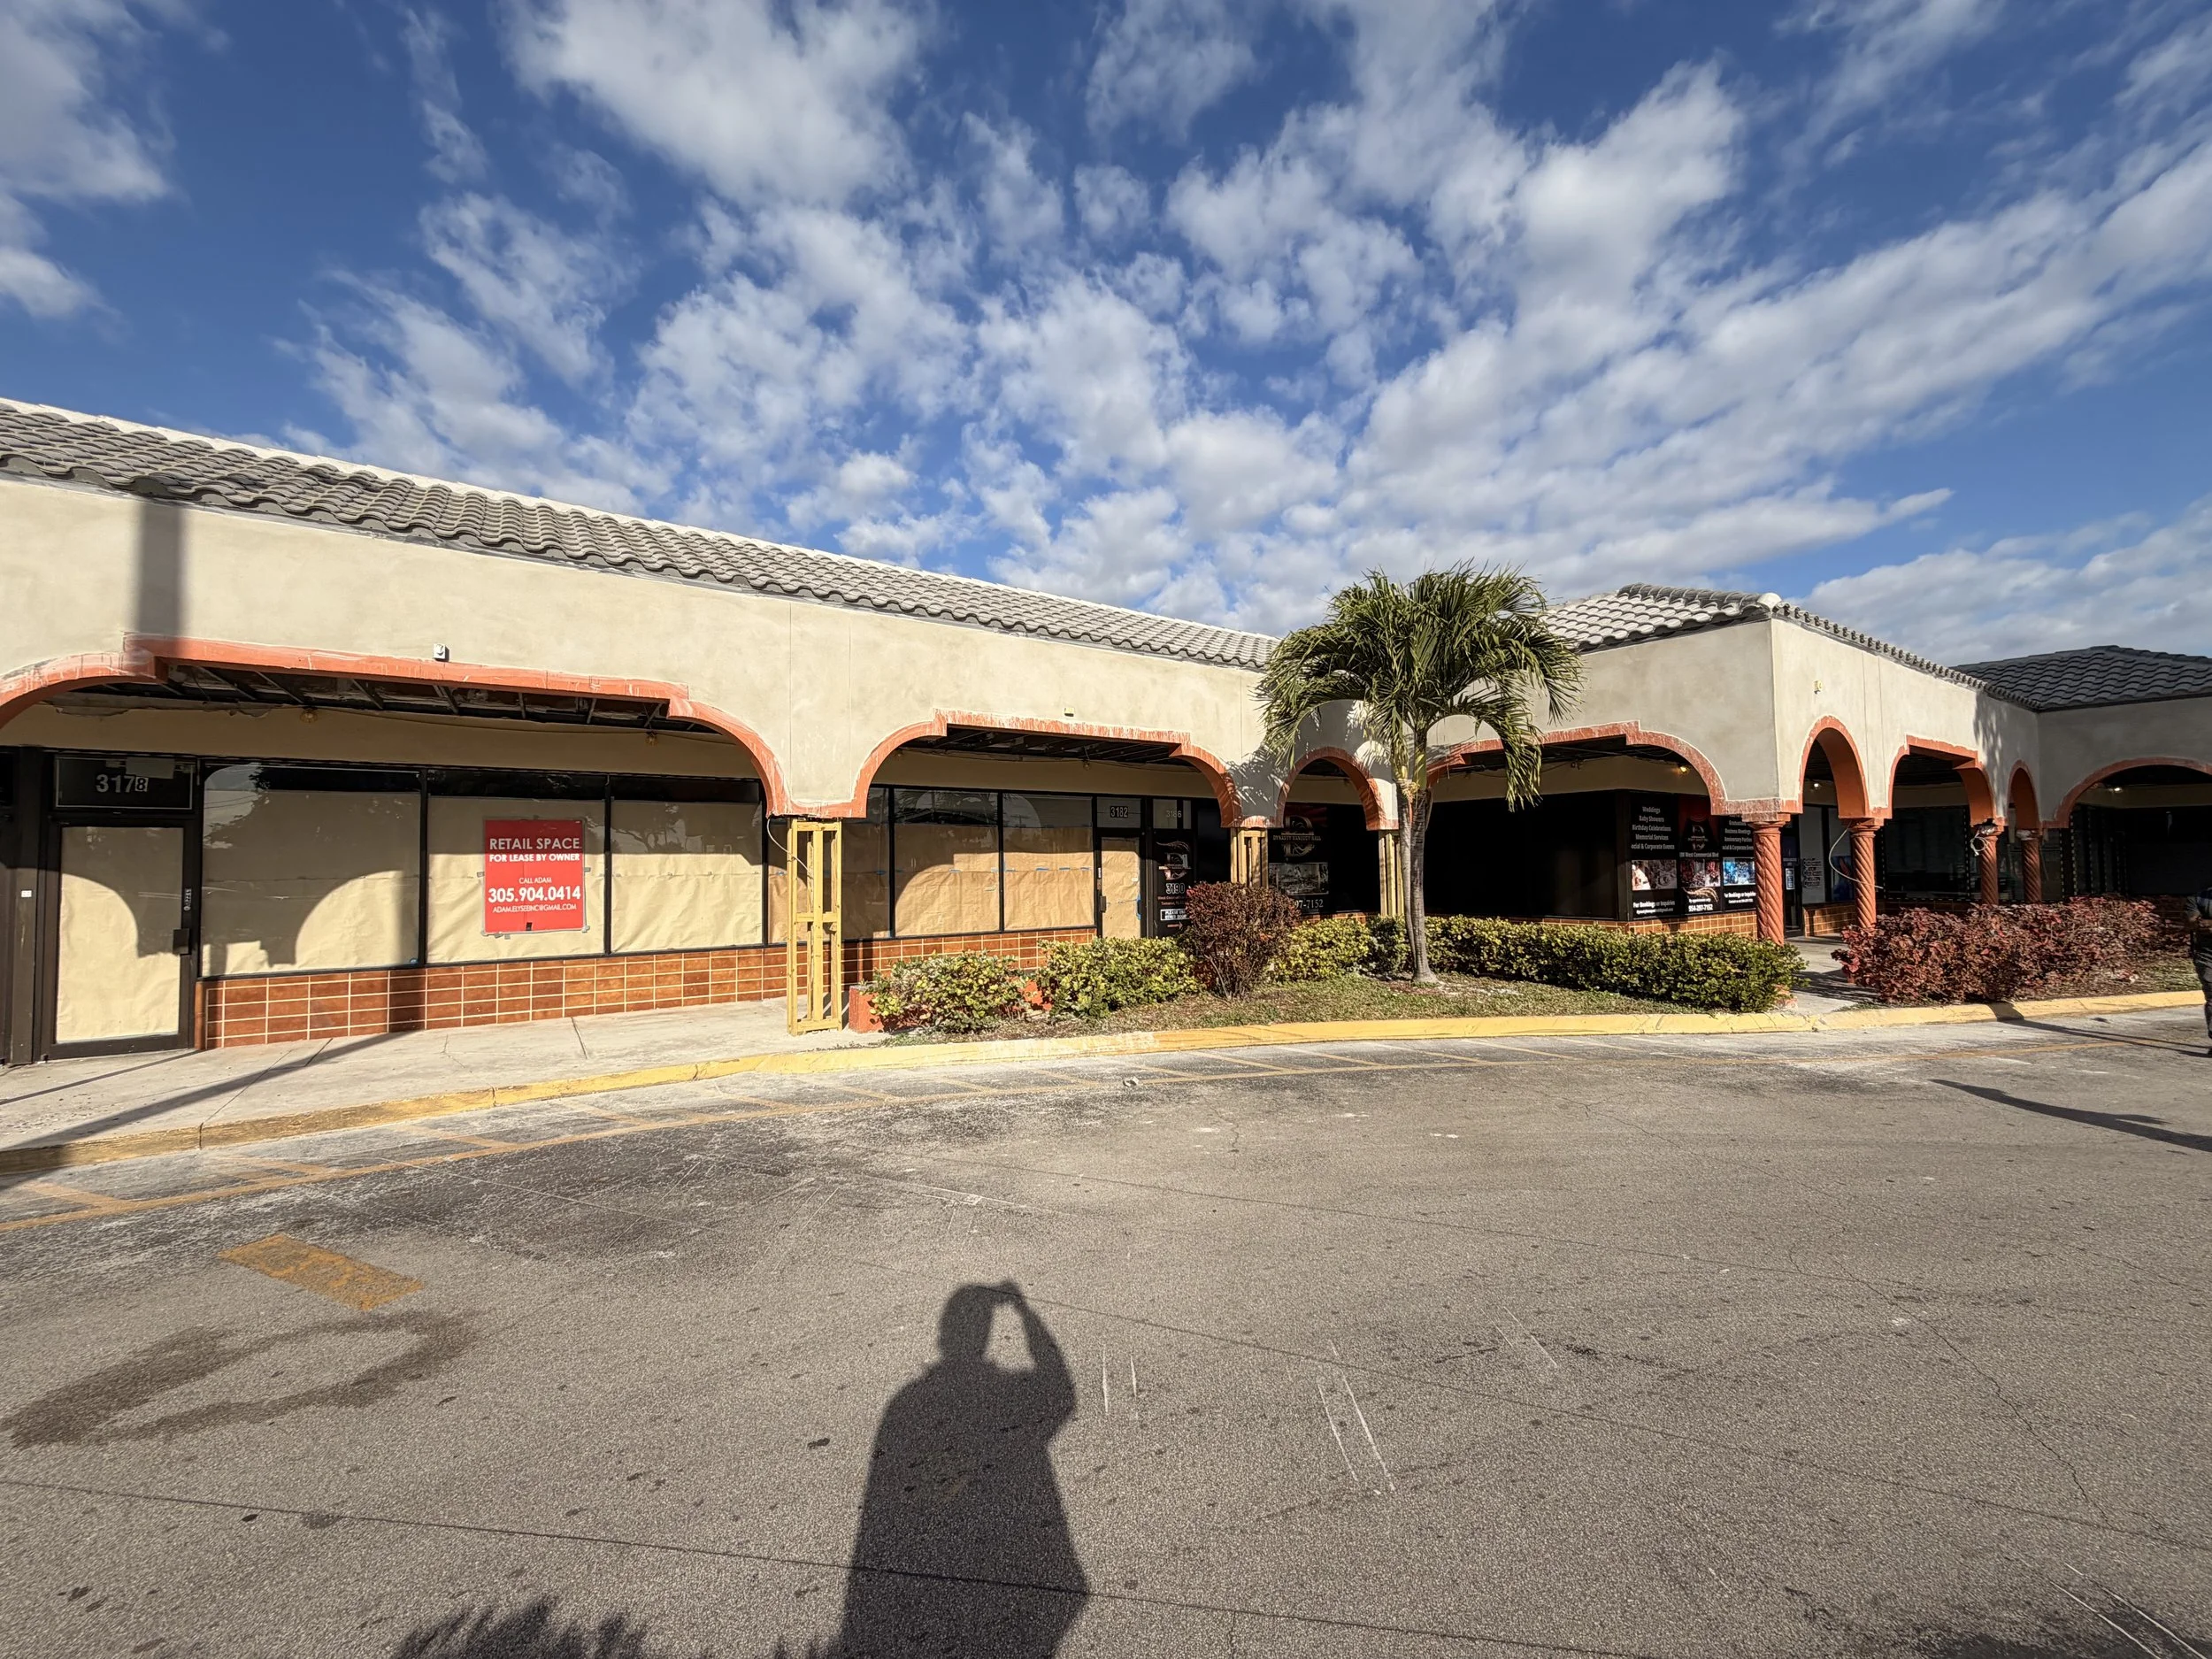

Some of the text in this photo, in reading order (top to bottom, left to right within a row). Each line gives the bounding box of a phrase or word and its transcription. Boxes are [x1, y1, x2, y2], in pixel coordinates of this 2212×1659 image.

[96, 774, 149, 793] 3178
[1110, 806, 1128, 818] 3182
[489, 837, 580, 850] RETAIL SPACE
[488, 886, 581, 902] 305.904.0414
[1165, 882, 1186, 895] 3190
